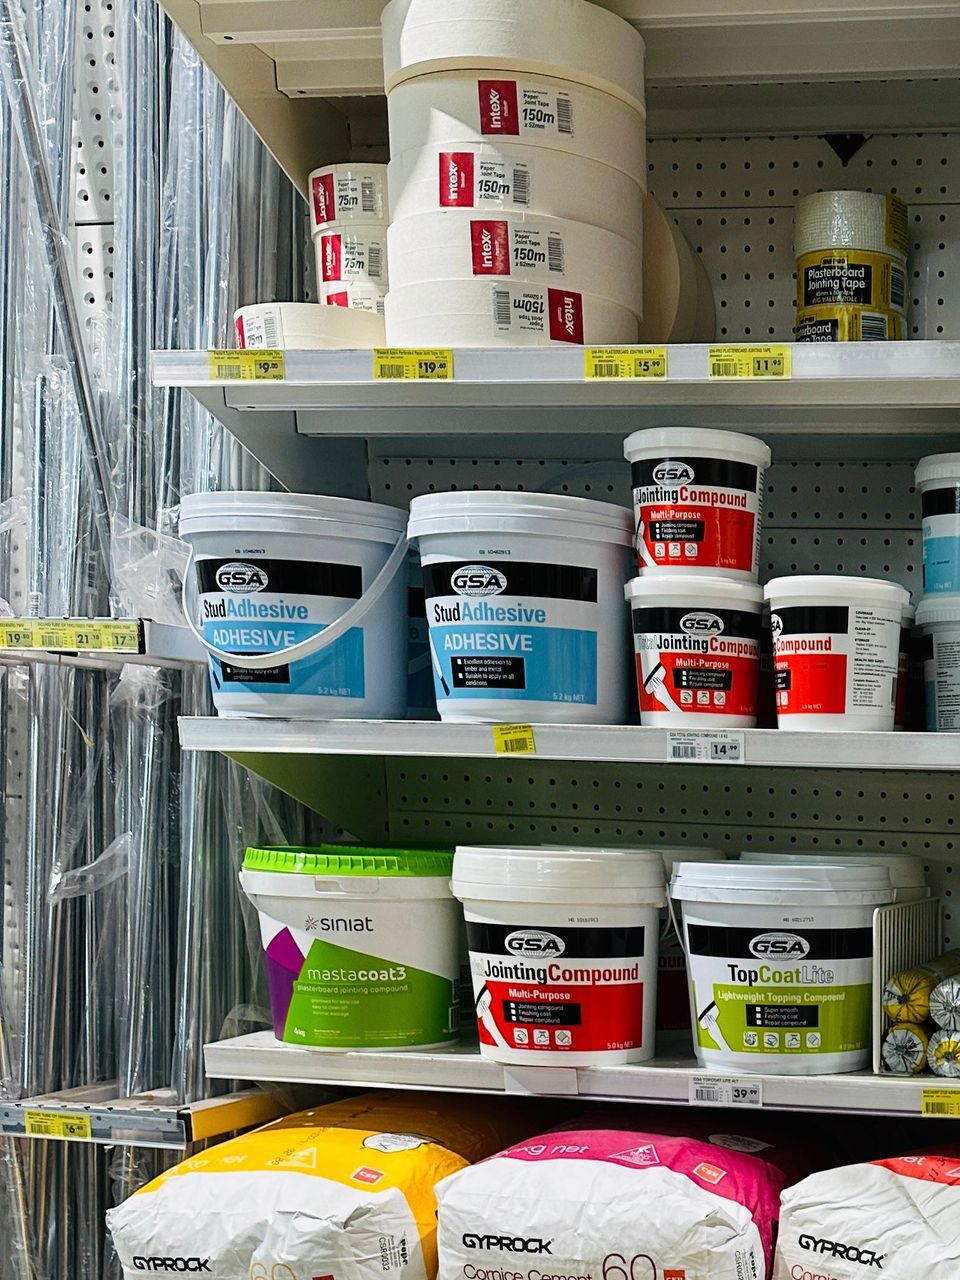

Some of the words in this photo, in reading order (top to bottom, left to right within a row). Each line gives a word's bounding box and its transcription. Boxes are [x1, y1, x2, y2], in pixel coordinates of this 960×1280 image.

[522, 108, 554, 124] 150m
[478, 180, 510, 194] 150m
[339, 195, 358, 206] 75m
[513, 247, 546, 262] 150m
[808, 267, 865, 279] Plasterboard
[808, 279, 839, 291] Jointing
[513, 300, 544, 313] 150m
[655, 469, 692, 480] GSA
[651, 510, 701, 519] Multi-Purpose
[218, 571, 264, 586] GSA
[454, 574, 503, 589] GSA
[682, 619, 721, 631] GSA
[213, 629, 295, 647] ADHESIVE
[444, 633, 533, 651] ADHESIVE
[676, 658, 730, 669] Multi-Purpose
[321, 917, 374, 932] siniat
[508, 939, 562, 952] GSA
[752, 941, 805, 954] GSA
[308, 967, 407, 982] mastacoat3
[340, 985, 368, 994] jointing
[370, 985, 408, 994] compound
[508, 988, 571, 1002] Multi-Purpose
[767, 992, 802, 1003] Topping
[803, 992, 846, 1002] Compound
[463, 1233, 552, 1254] GYPROCK
[799, 1234, 886, 1269] GYPROCK
[133, 1256, 212, 1272] GYPROCK
